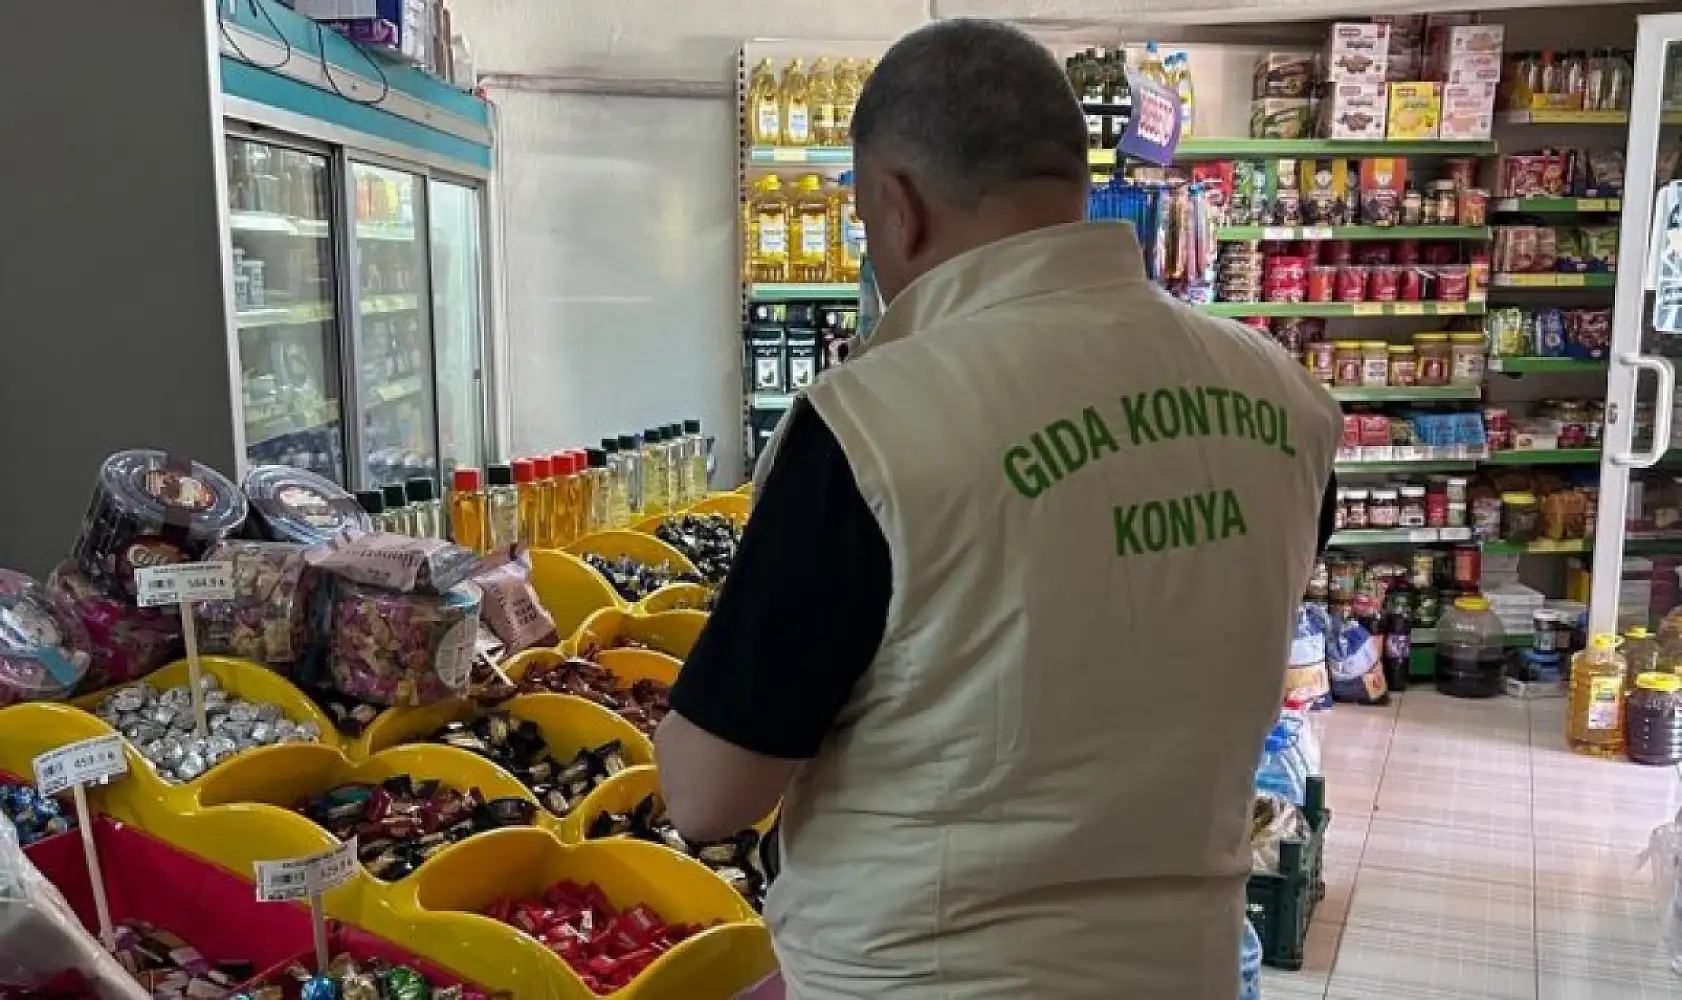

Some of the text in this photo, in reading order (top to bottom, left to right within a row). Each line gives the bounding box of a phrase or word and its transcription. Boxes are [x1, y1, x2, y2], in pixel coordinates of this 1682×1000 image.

[1003, 386, 1296, 499] GIDA KONTROL
[1114, 489, 1247, 556] KONYA
